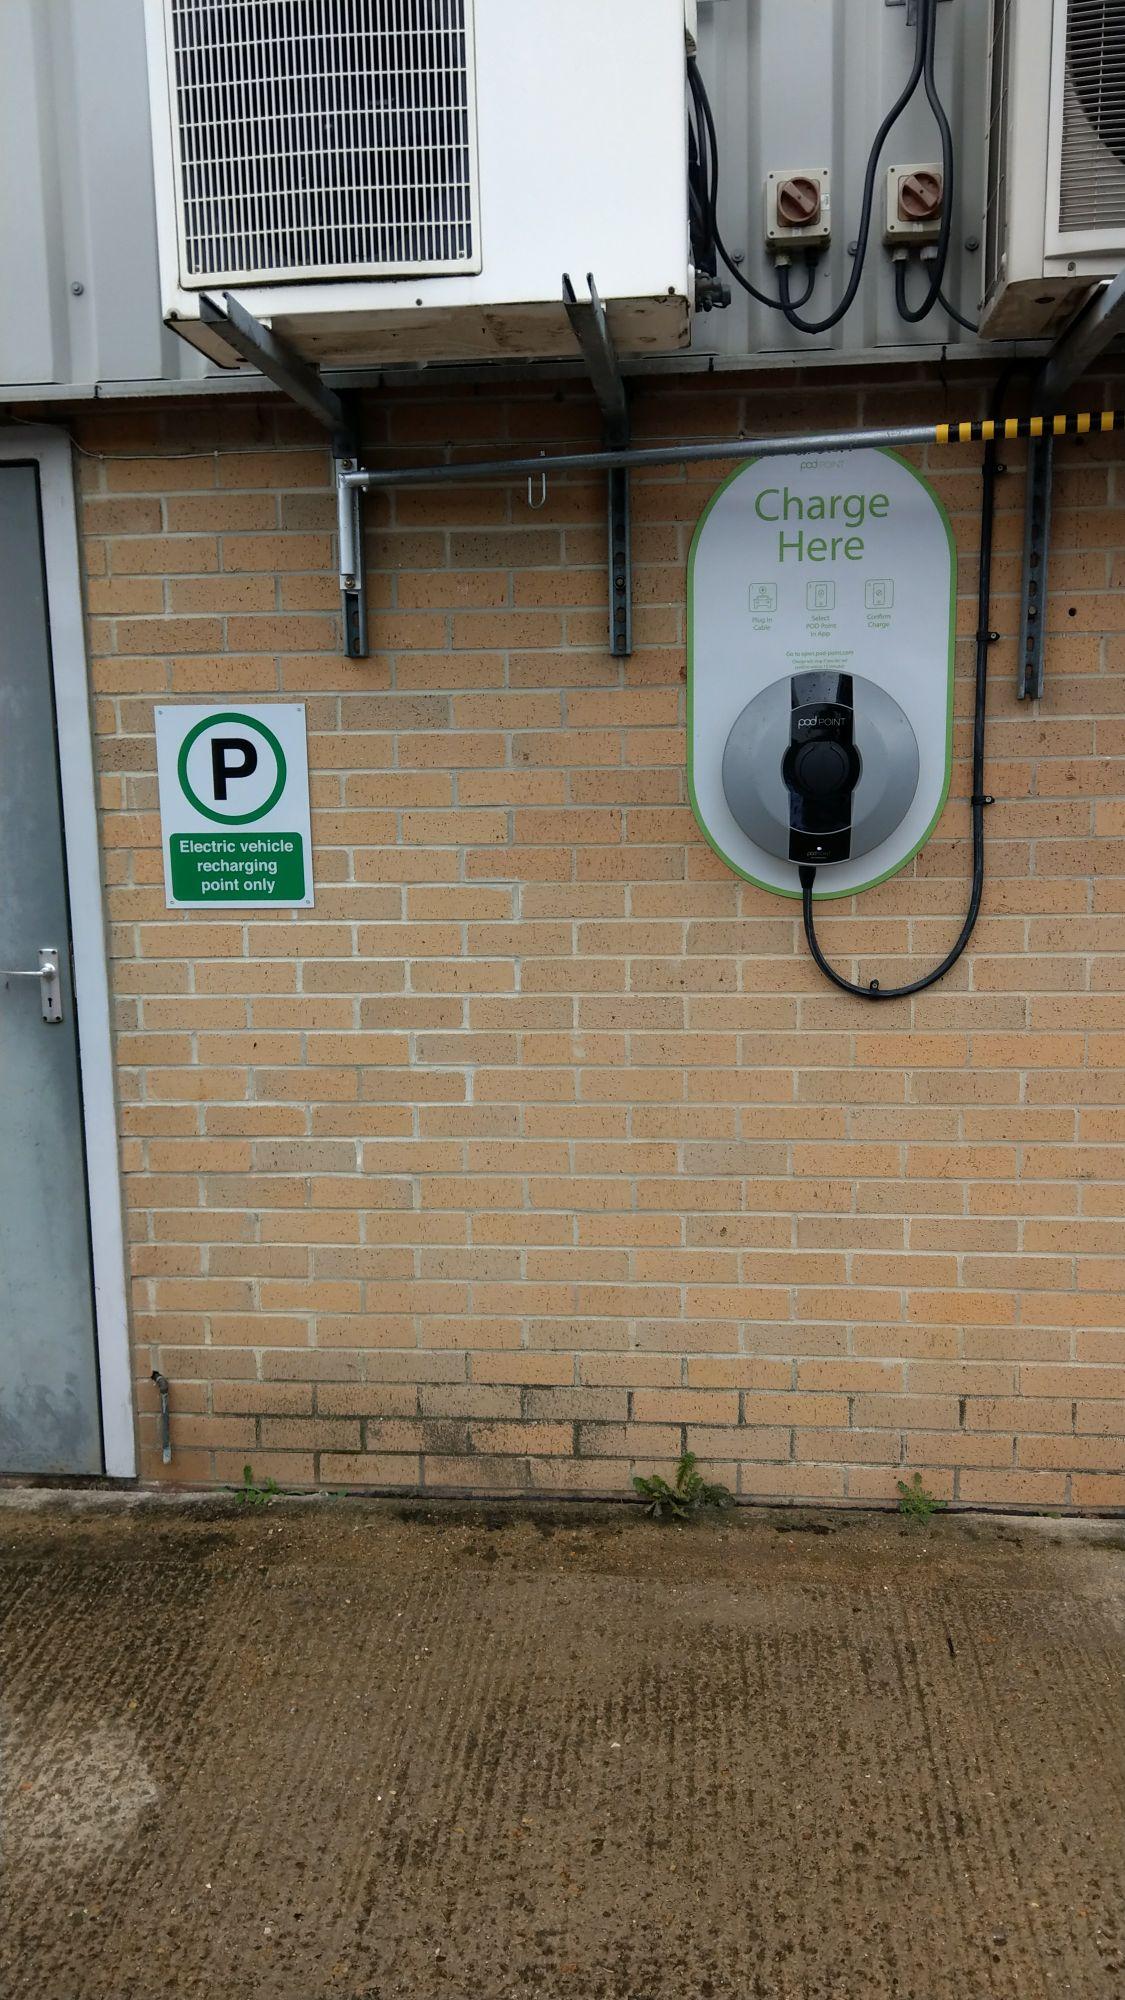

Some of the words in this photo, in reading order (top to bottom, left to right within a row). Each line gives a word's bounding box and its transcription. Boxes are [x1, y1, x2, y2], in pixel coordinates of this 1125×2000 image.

[755, 487, 890, 528] Charge
[779, 530, 865, 562] Here
[866, 613, 892, 621] Confirm
[868, 621, 890, 629] Charge
[798, 716, 817, 729] pod
[818, 717, 846, 726] POINT
[211, 738, 258, 801] P
[179, 839, 236, 853] Electric
[240, 839, 294, 853] vehicle
[197, 858, 278, 875] recharging
[201, 878, 240, 895] point
[243, 878, 276, 894] only
